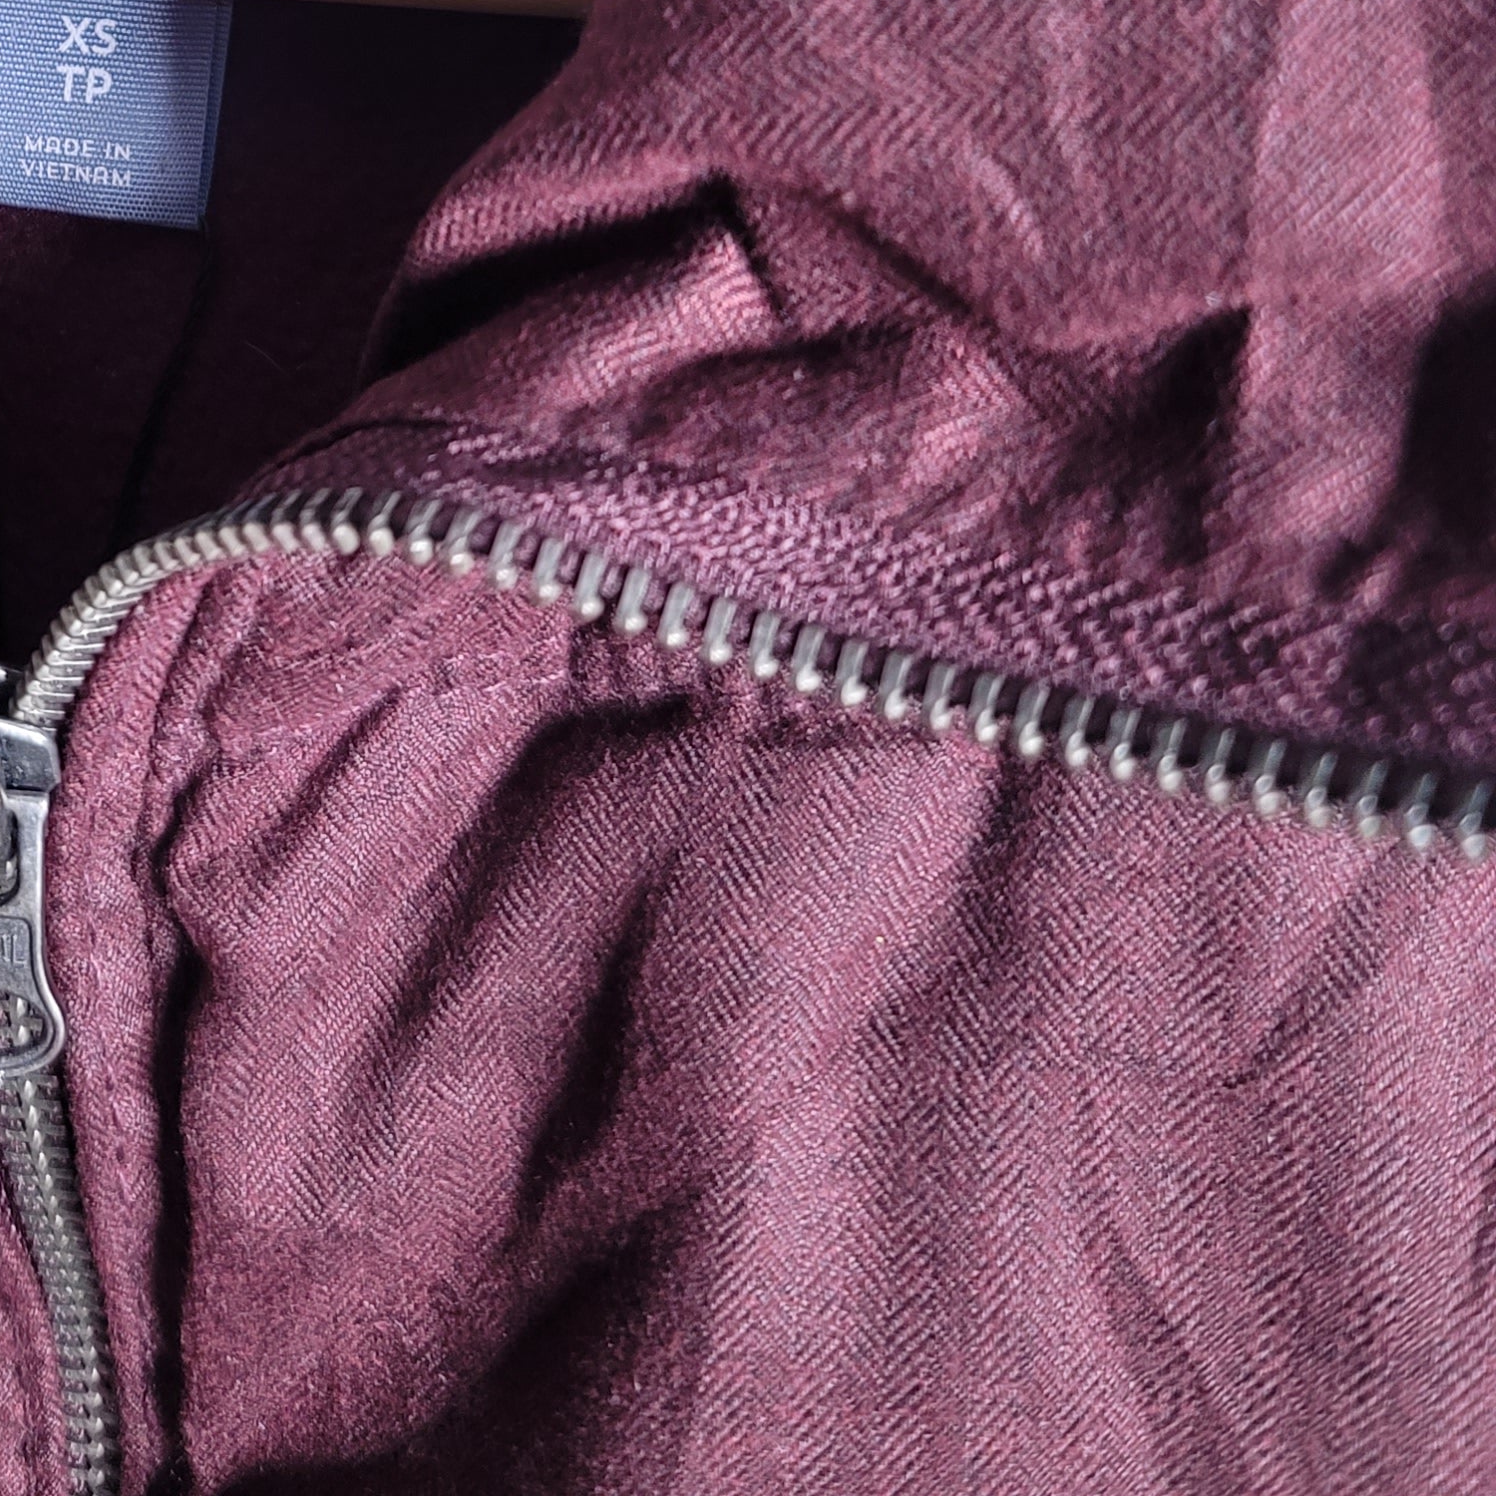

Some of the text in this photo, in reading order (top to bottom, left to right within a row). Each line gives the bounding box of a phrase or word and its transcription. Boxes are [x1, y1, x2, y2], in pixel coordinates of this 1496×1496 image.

[56, 15, 118, 54] XS
[56, 63, 112, 102] TP
[24, 135, 131, 160] MADE IN
[21, 159, 131, 186] VIETNAM
